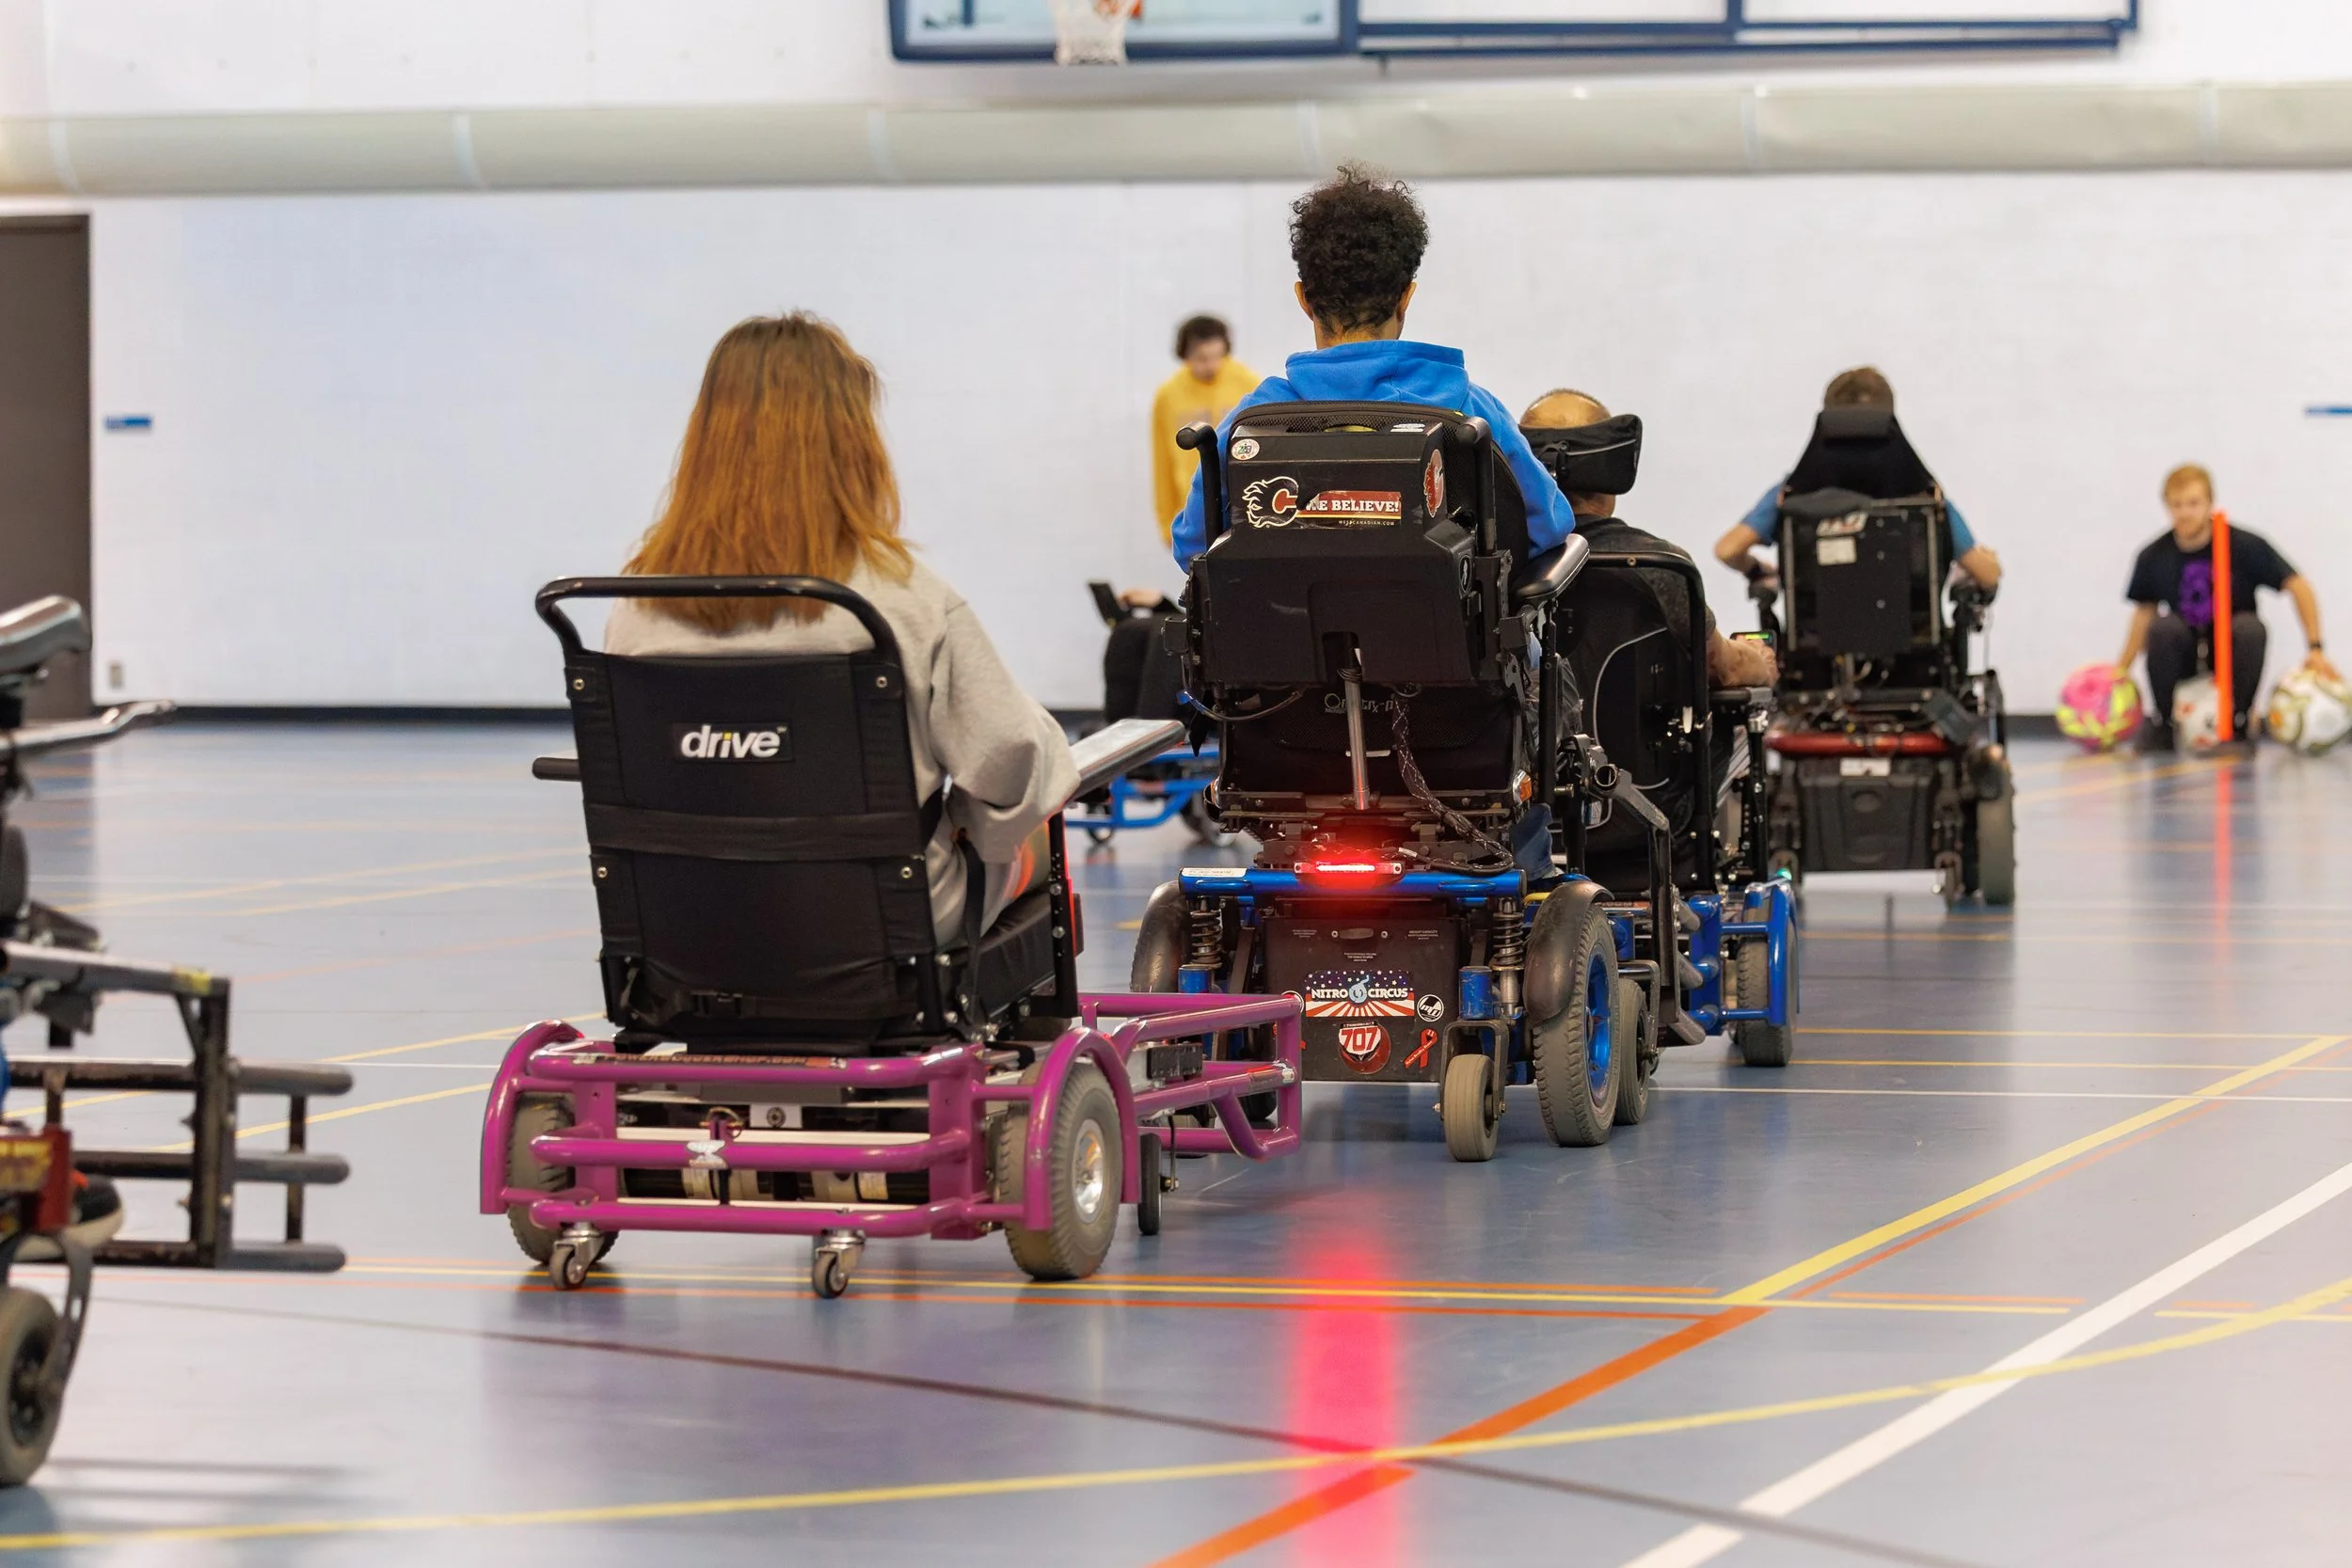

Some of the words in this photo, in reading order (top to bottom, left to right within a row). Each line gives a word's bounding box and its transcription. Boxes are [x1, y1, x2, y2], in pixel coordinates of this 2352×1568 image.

[1331, 499, 1399, 513] BELIEVE!
[680, 723, 781, 759] drive
[1311, 988, 1349, 999] NITRO
[1367, 988, 1409, 999] CIRCUS
[1341, 1027, 1379, 1052] 707
